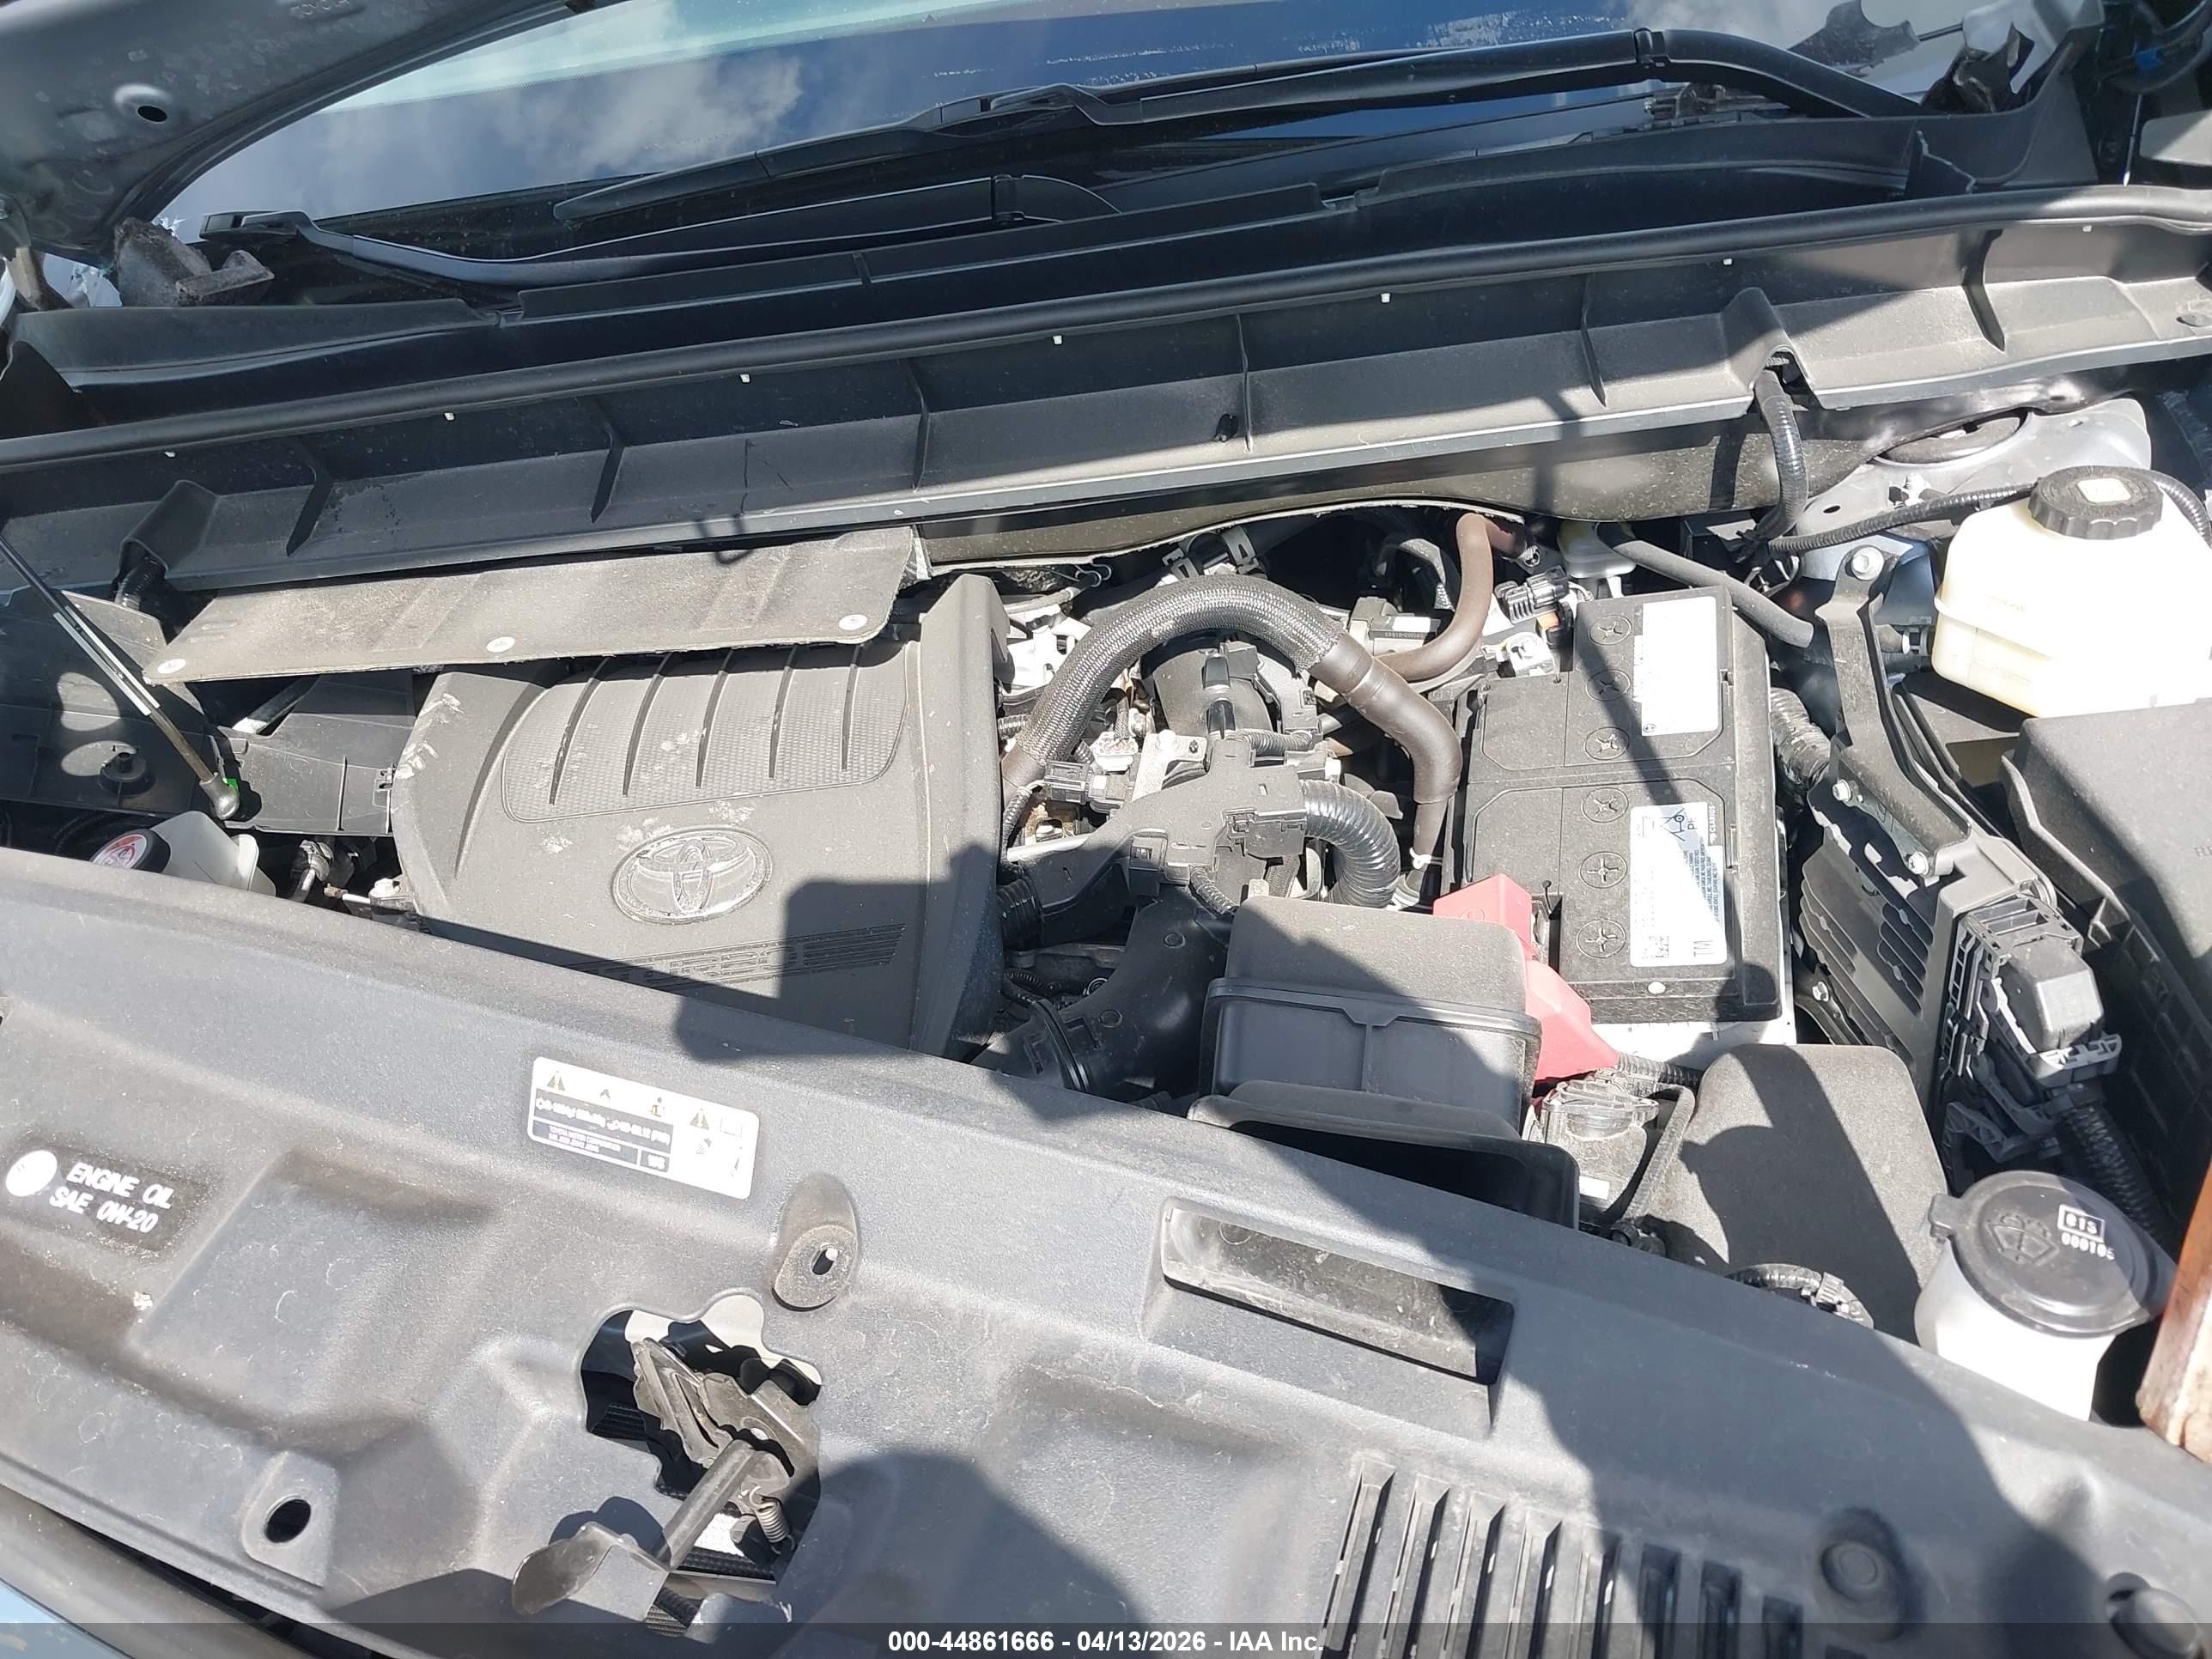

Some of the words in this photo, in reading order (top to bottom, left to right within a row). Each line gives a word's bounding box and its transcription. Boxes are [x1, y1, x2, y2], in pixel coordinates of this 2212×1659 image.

[66, 1162, 140, 1197] ENGINE
[143, 1184, 174, 1209] OIL
[49, 1187, 94, 1214] SAE
[96, 1200, 159, 1233] 0W-20
